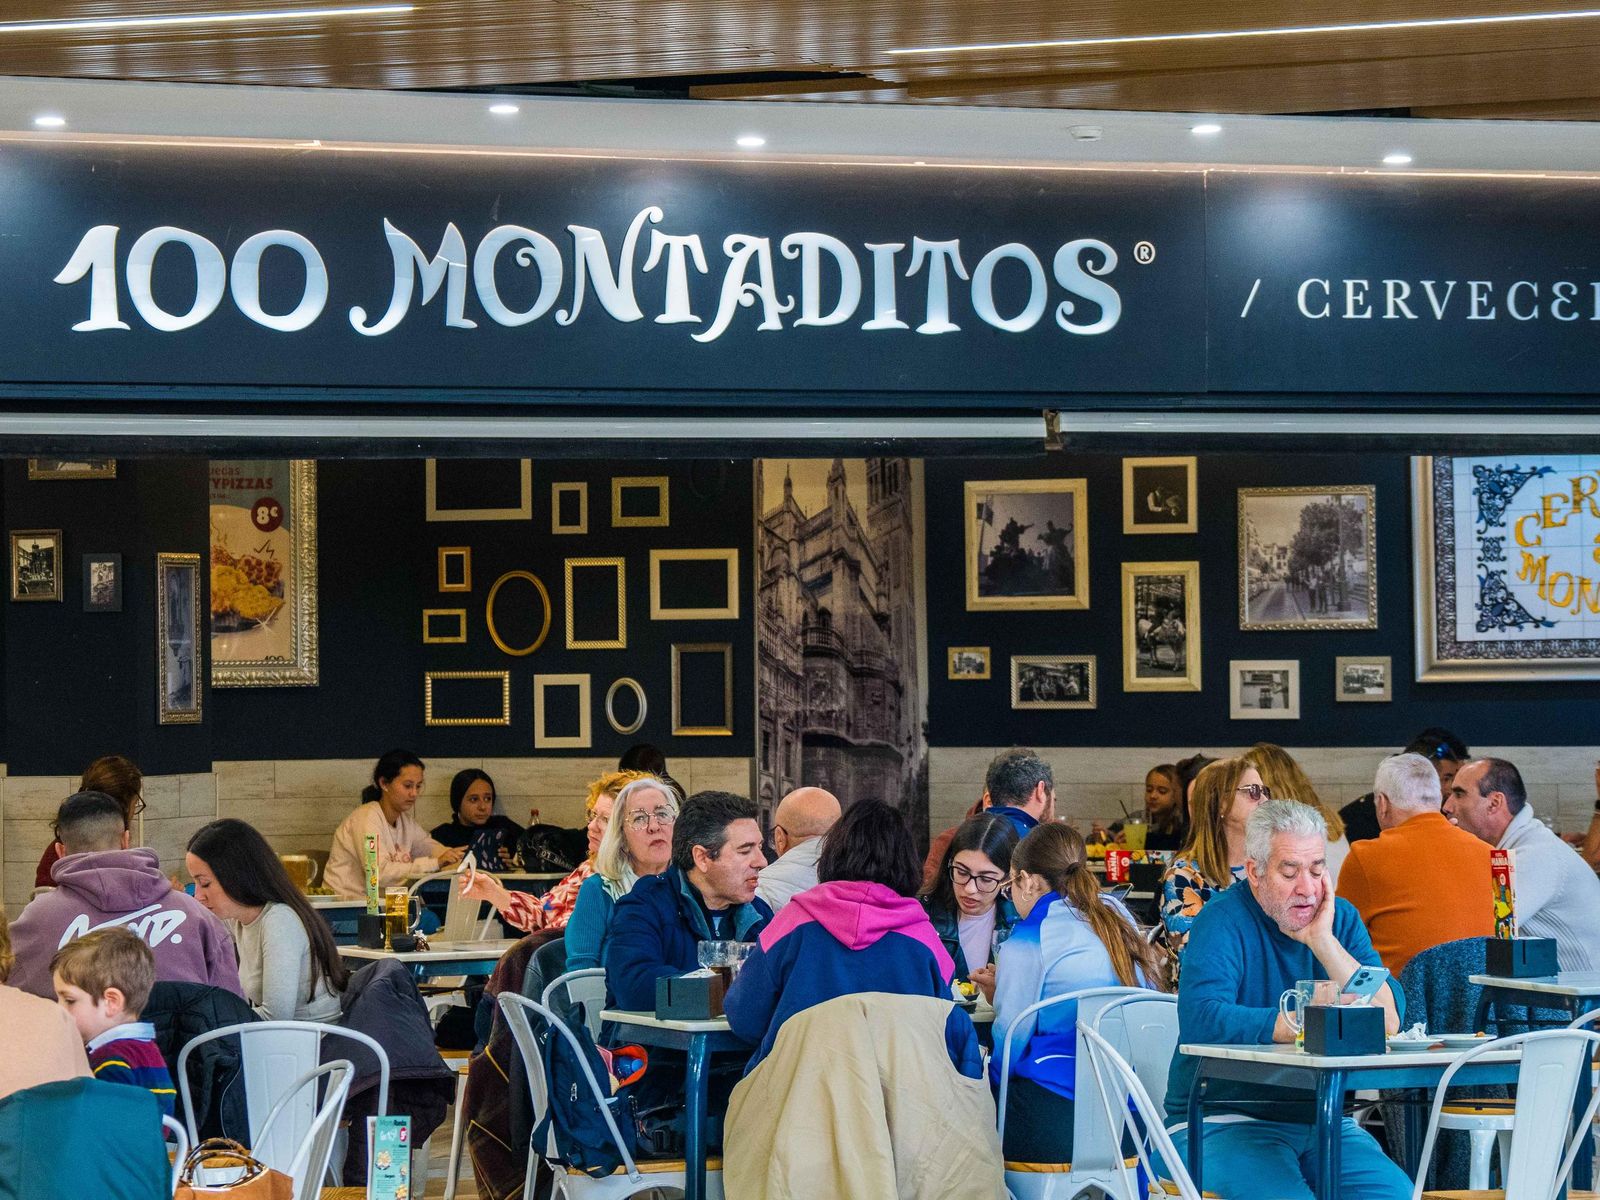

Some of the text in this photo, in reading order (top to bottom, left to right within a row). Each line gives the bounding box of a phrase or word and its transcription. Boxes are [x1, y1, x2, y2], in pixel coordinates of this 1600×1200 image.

[53, 224, 329, 333] 100
[349, 206, 1122, 343] MONTADITOS
[1297, 278, 1600, 321] CERVECE
[1514, 470, 1600, 548] CER
